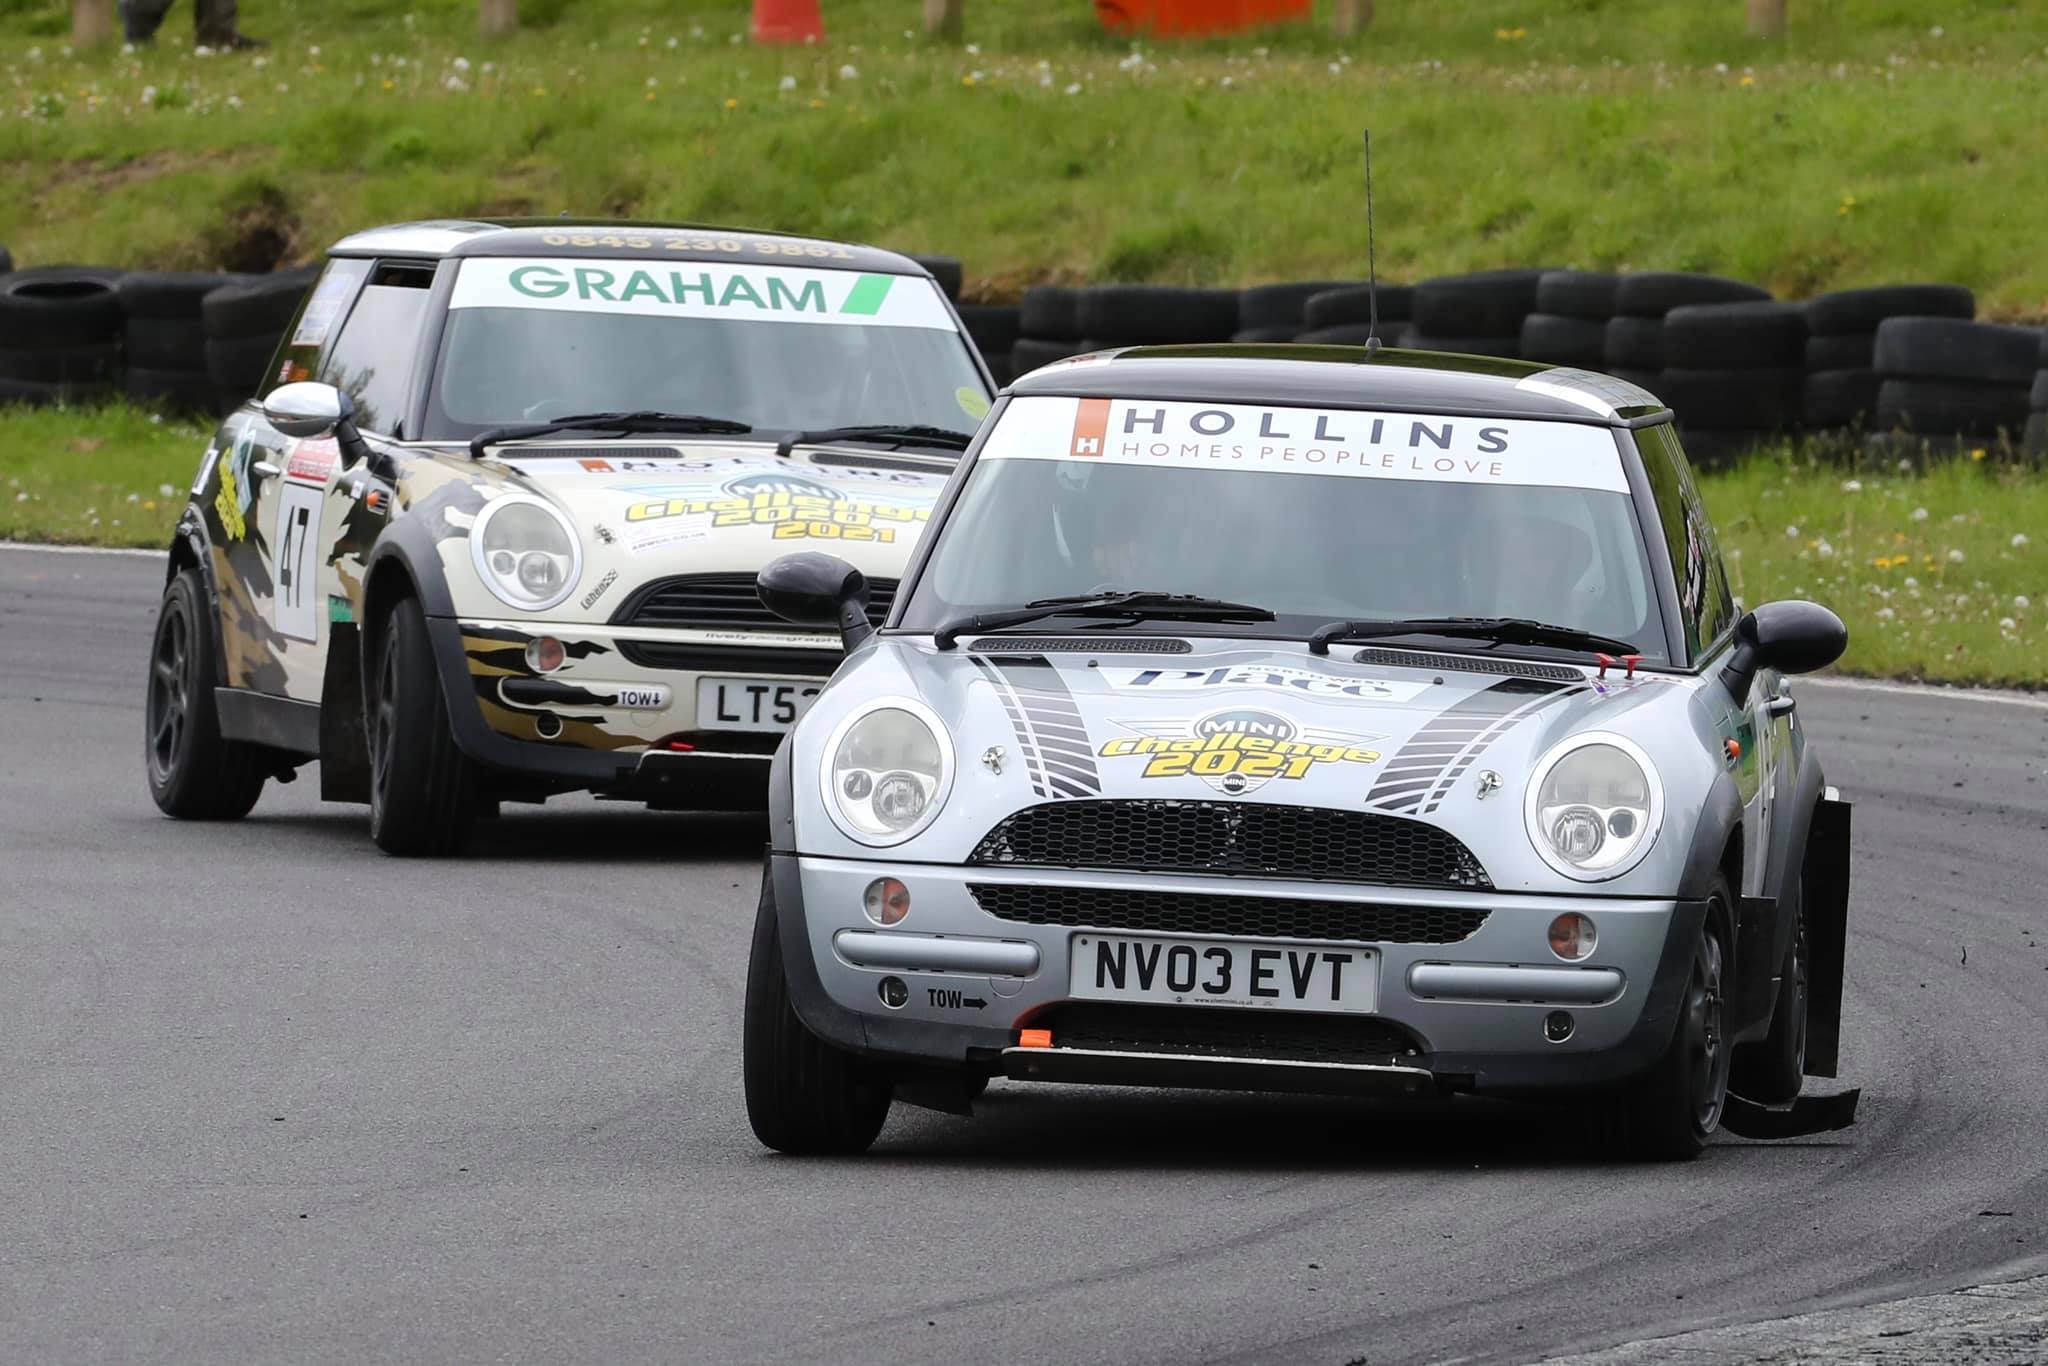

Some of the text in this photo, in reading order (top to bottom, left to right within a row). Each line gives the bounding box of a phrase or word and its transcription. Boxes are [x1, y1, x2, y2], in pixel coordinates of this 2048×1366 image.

[542, 233, 652, 249] 0845
[664, 237, 742, 254] 230
[508, 265, 827, 313] GRAHAM
[1123, 408, 1509, 454] HOLLINS
[1122, 442, 1503, 476] HOMES PEOPLE LOVE
[732, 483, 841, 500] MINI
[711, 506, 873, 528] 2020
[772, 521, 896, 543] 2021
[280, 505, 310, 608] 47
[1128, 668, 1393, 698] Place
[620, 690, 651, 705] TOW
[1203, 719, 1288, 738] MINI
[1097, 732, 1383, 764] Challenge
[1140, 749, 1315, 780] 2021
[1223, 778, 1246, 787] MINI
[1095, 940, 1353, 1001] NV03 EVT
[927, 988, 962, 1009] TOW
